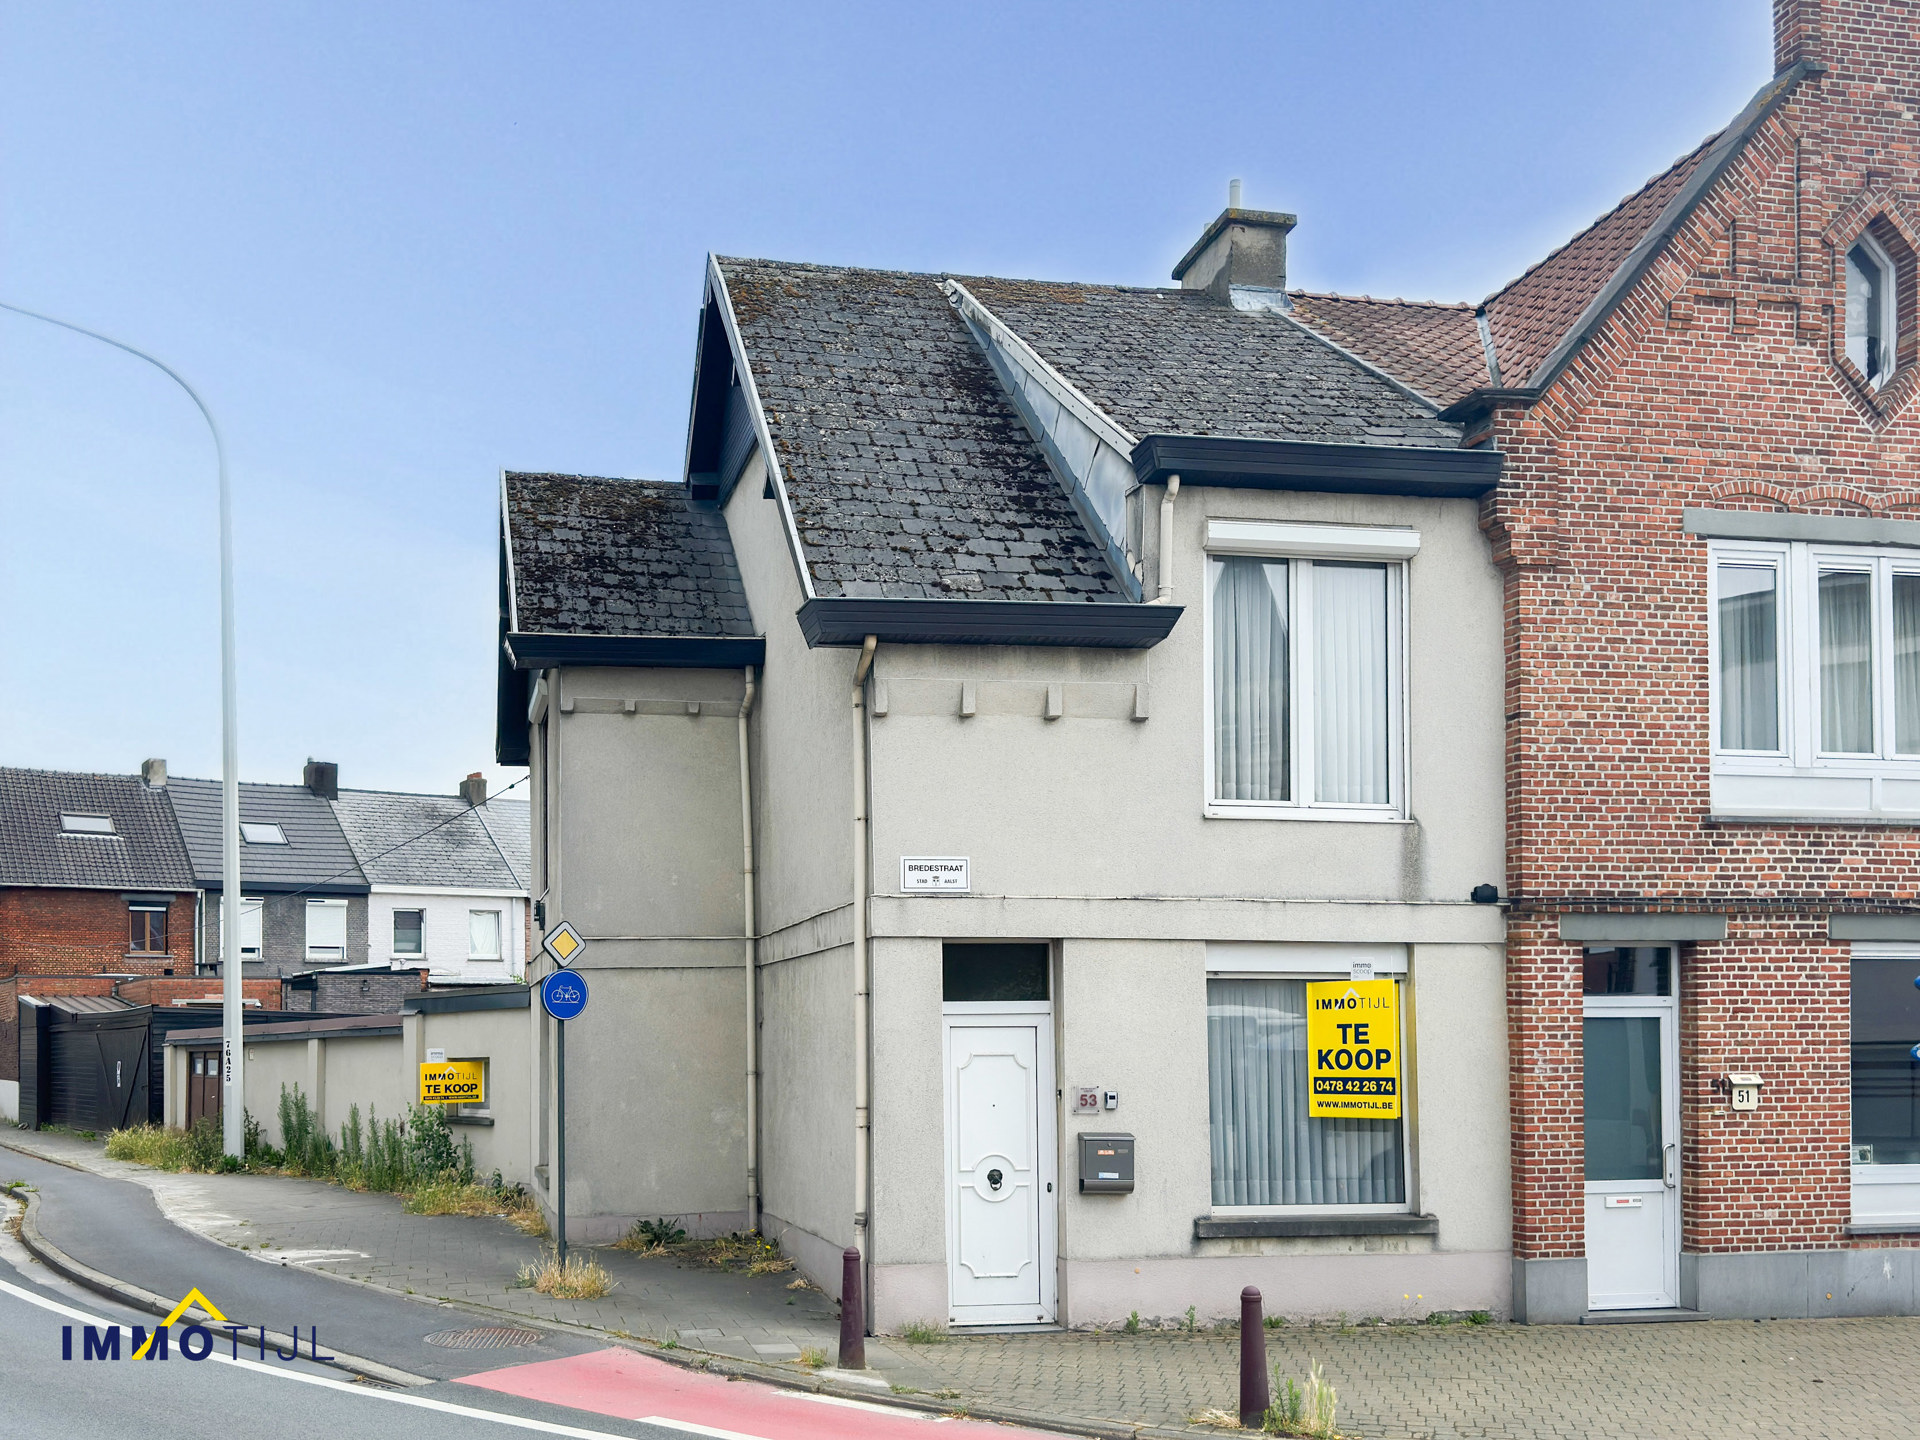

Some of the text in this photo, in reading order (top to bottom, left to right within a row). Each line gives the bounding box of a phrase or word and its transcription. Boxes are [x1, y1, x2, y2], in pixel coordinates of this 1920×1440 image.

[1315, 997, 1390, 1010] IMMOTIJL
[1336, 1023, 1370, 1045] TE
[1317, 1048, 1392, 1070] KOOP
[424, 1073, 477, 1081] IMMOTIJL
[425, 1083, 478, 1094] TE KOOP
[1316, 1080, 1393, 1092] 0478 42 26 74
[1080, 1094, 1097, 1106] 53
[1738, 1089, 1750, 1103] 51
[1317, 1101, 1393, 1109] WWW.IMMOTIJL.BE
